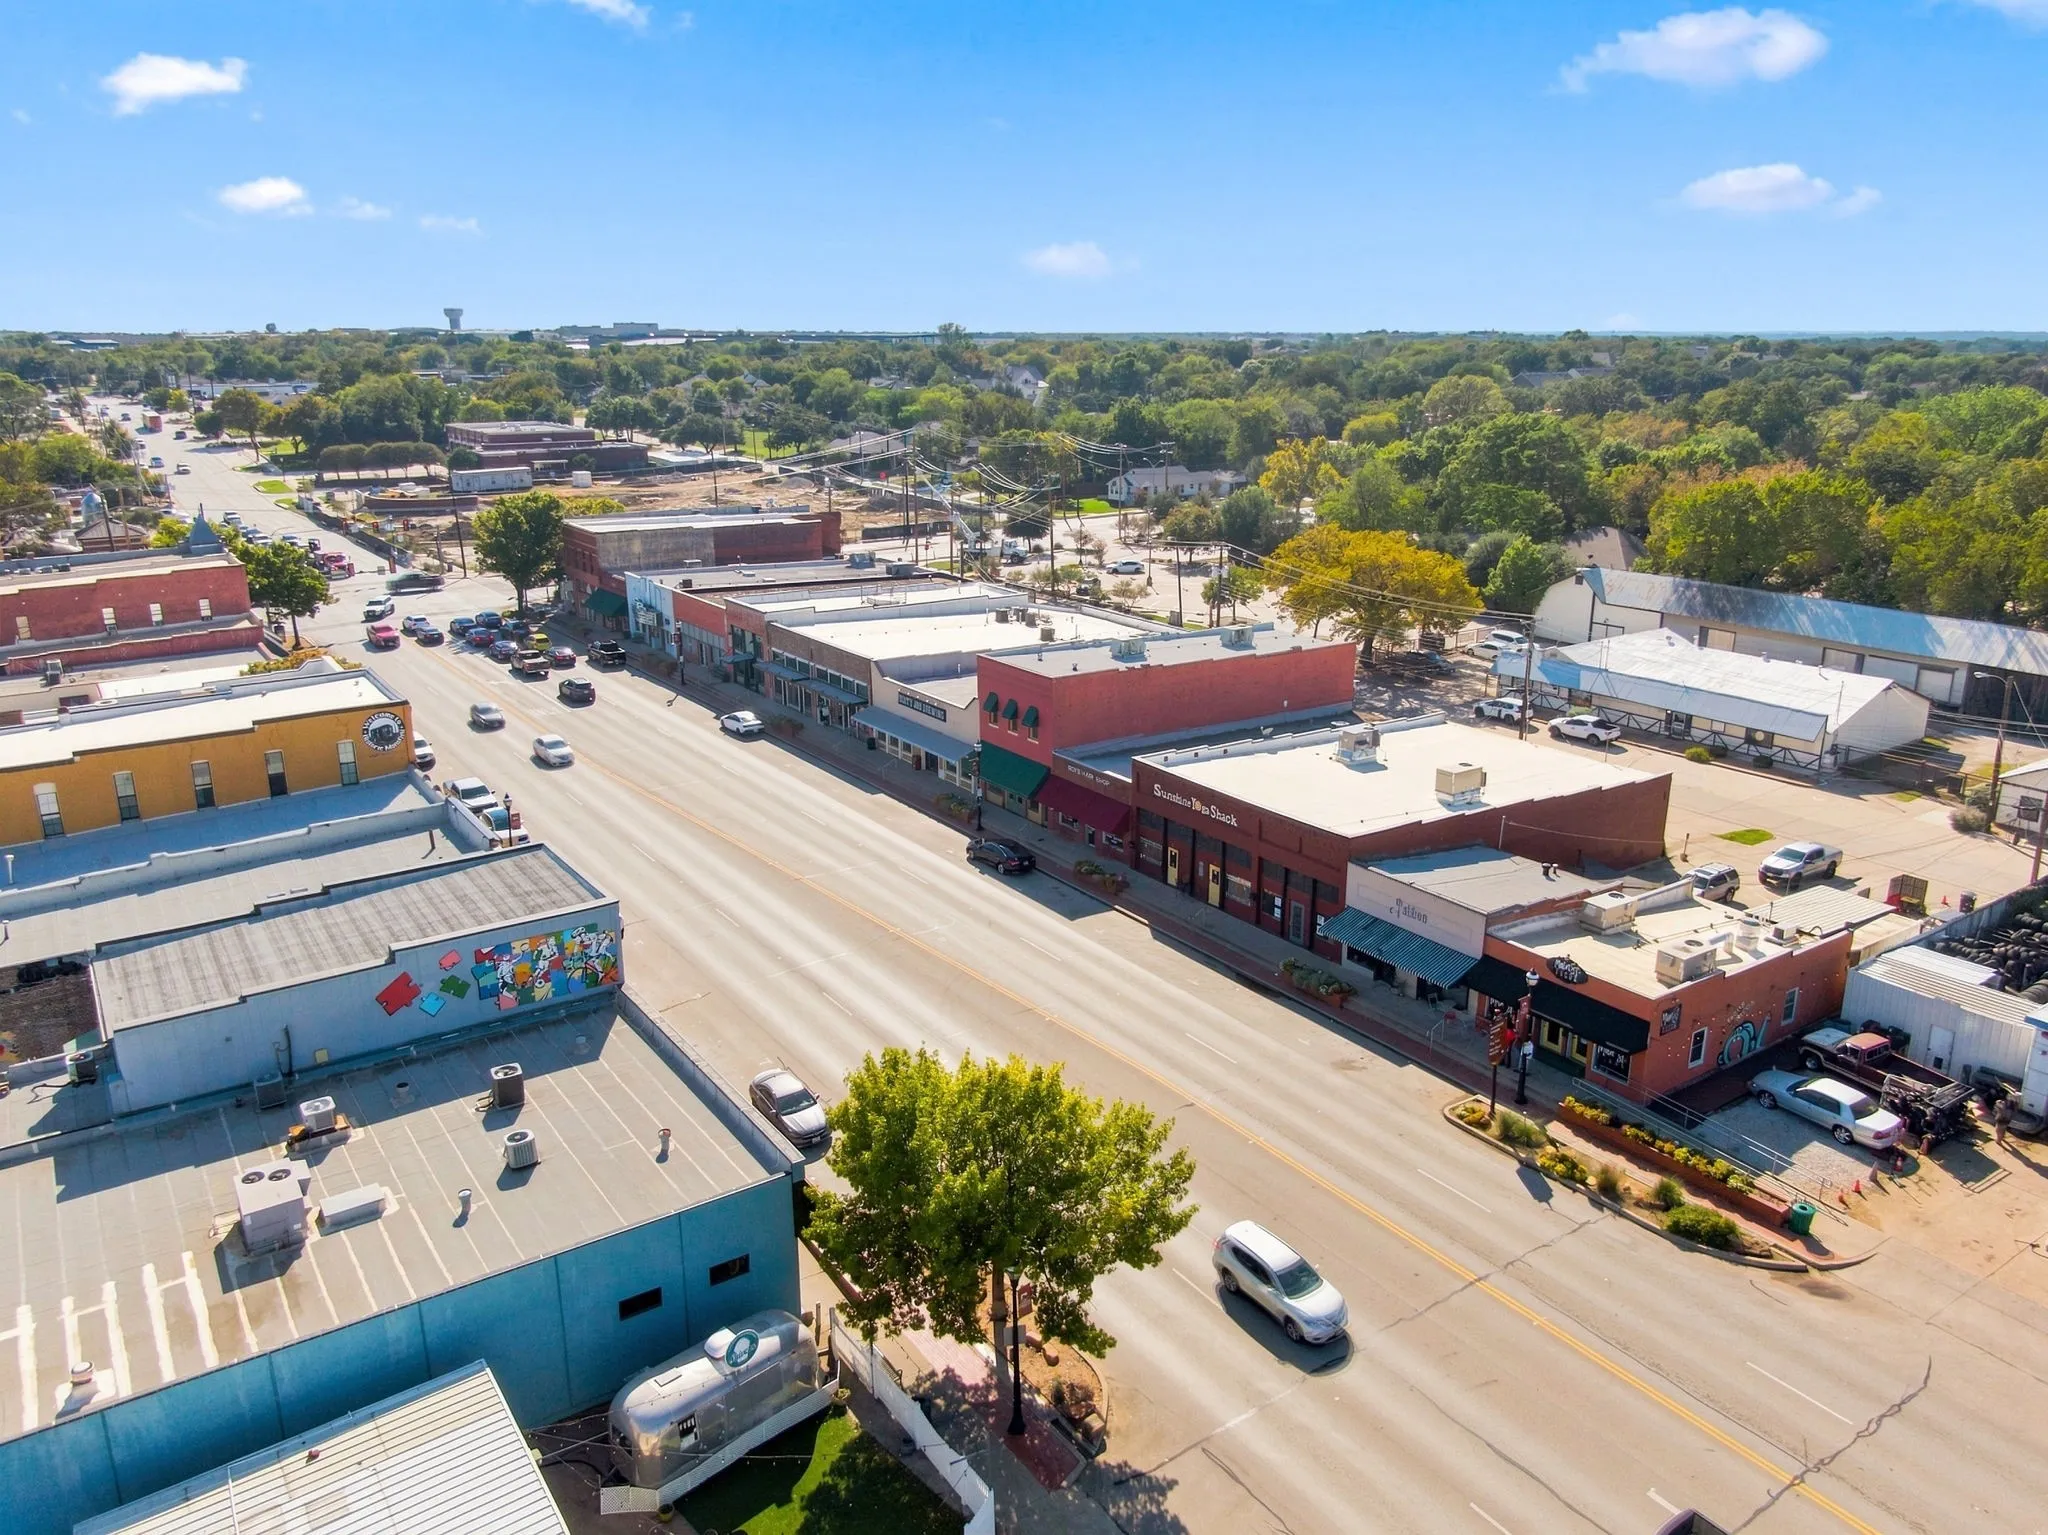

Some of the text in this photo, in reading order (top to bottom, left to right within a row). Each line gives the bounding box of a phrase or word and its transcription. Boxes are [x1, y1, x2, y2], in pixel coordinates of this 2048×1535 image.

[363, 712, 402, 729] Welcome to
[1153, 784, 1238, 827] Sunshine Yoga Shack
